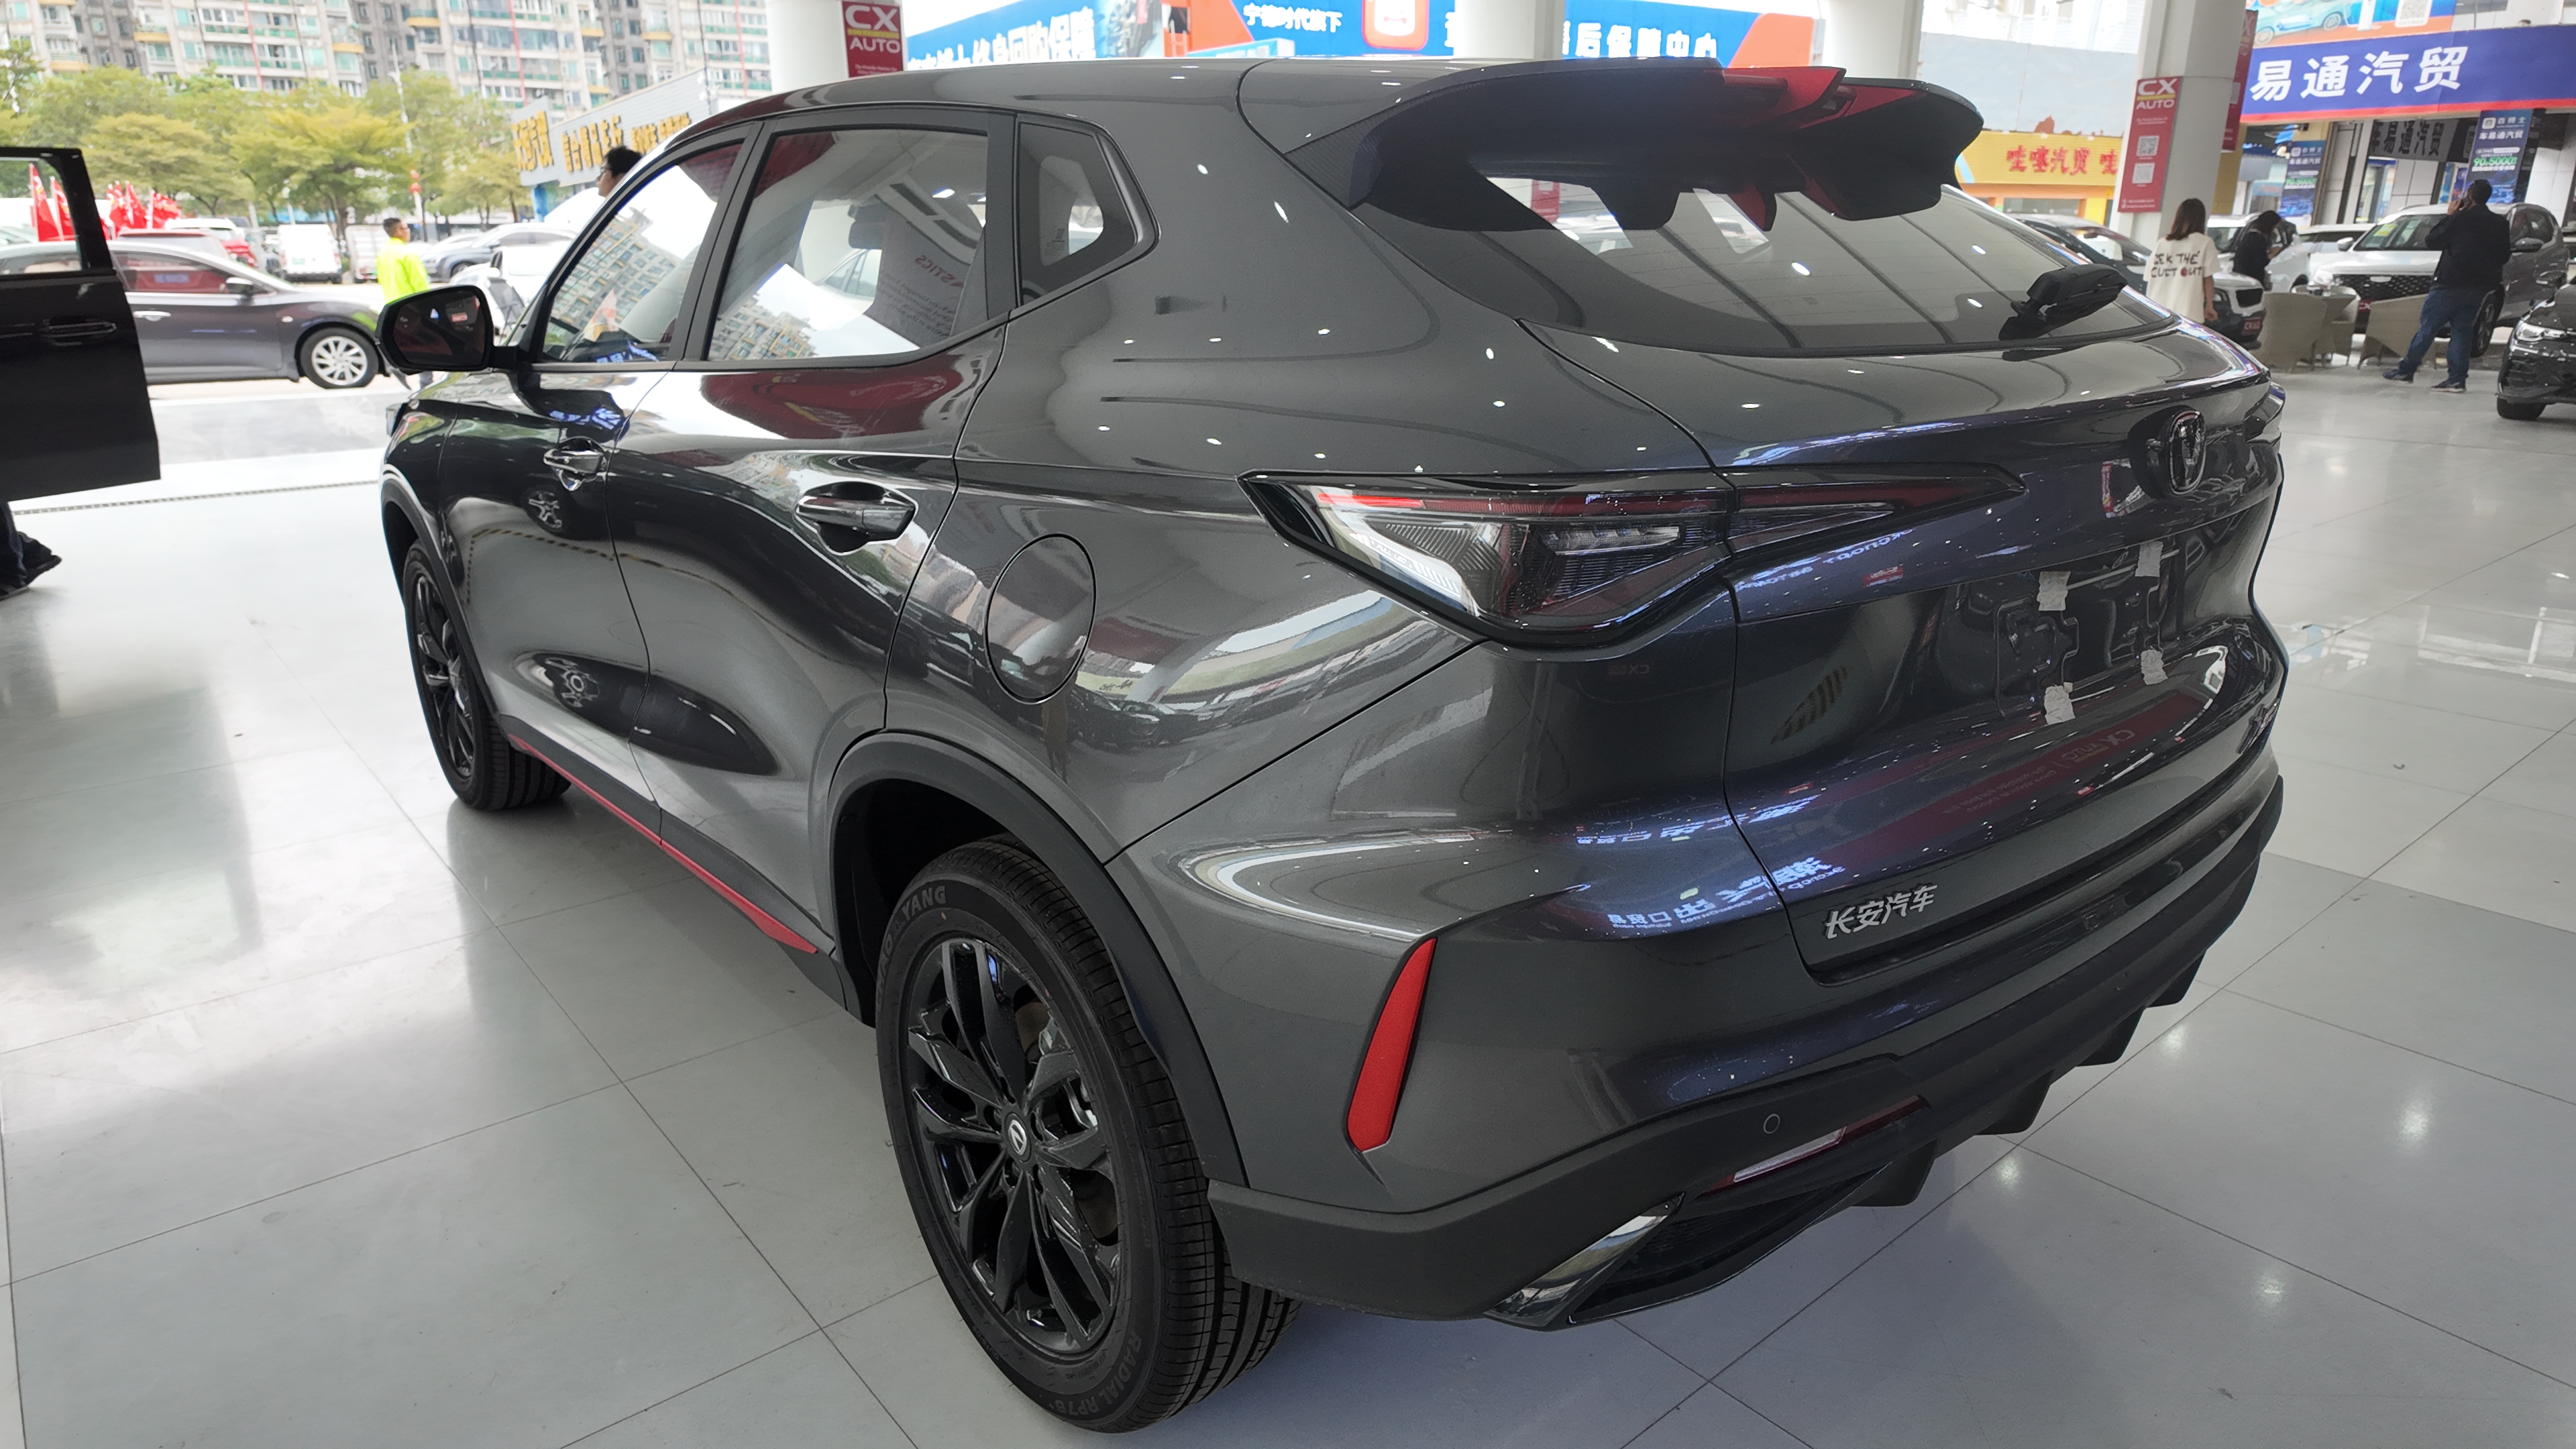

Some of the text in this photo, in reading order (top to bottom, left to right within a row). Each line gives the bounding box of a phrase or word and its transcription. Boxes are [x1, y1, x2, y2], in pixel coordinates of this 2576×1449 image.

[845, 5, 899, 32] CX
[849, 36, 900, 54] AUTO
[2137, 78, 2178, 95] CX
[2249, 46, 2469, 102] 易通汽贸
[2135, 99, 2175, 110] AUTO
[1377, 544, 1407, 564] FULL LED
[901, 885, 947, 921] YANG
[1825, 884, 1938, 939] 长安汽车
[1099, 1331, 1142, 1404] RADIAL
